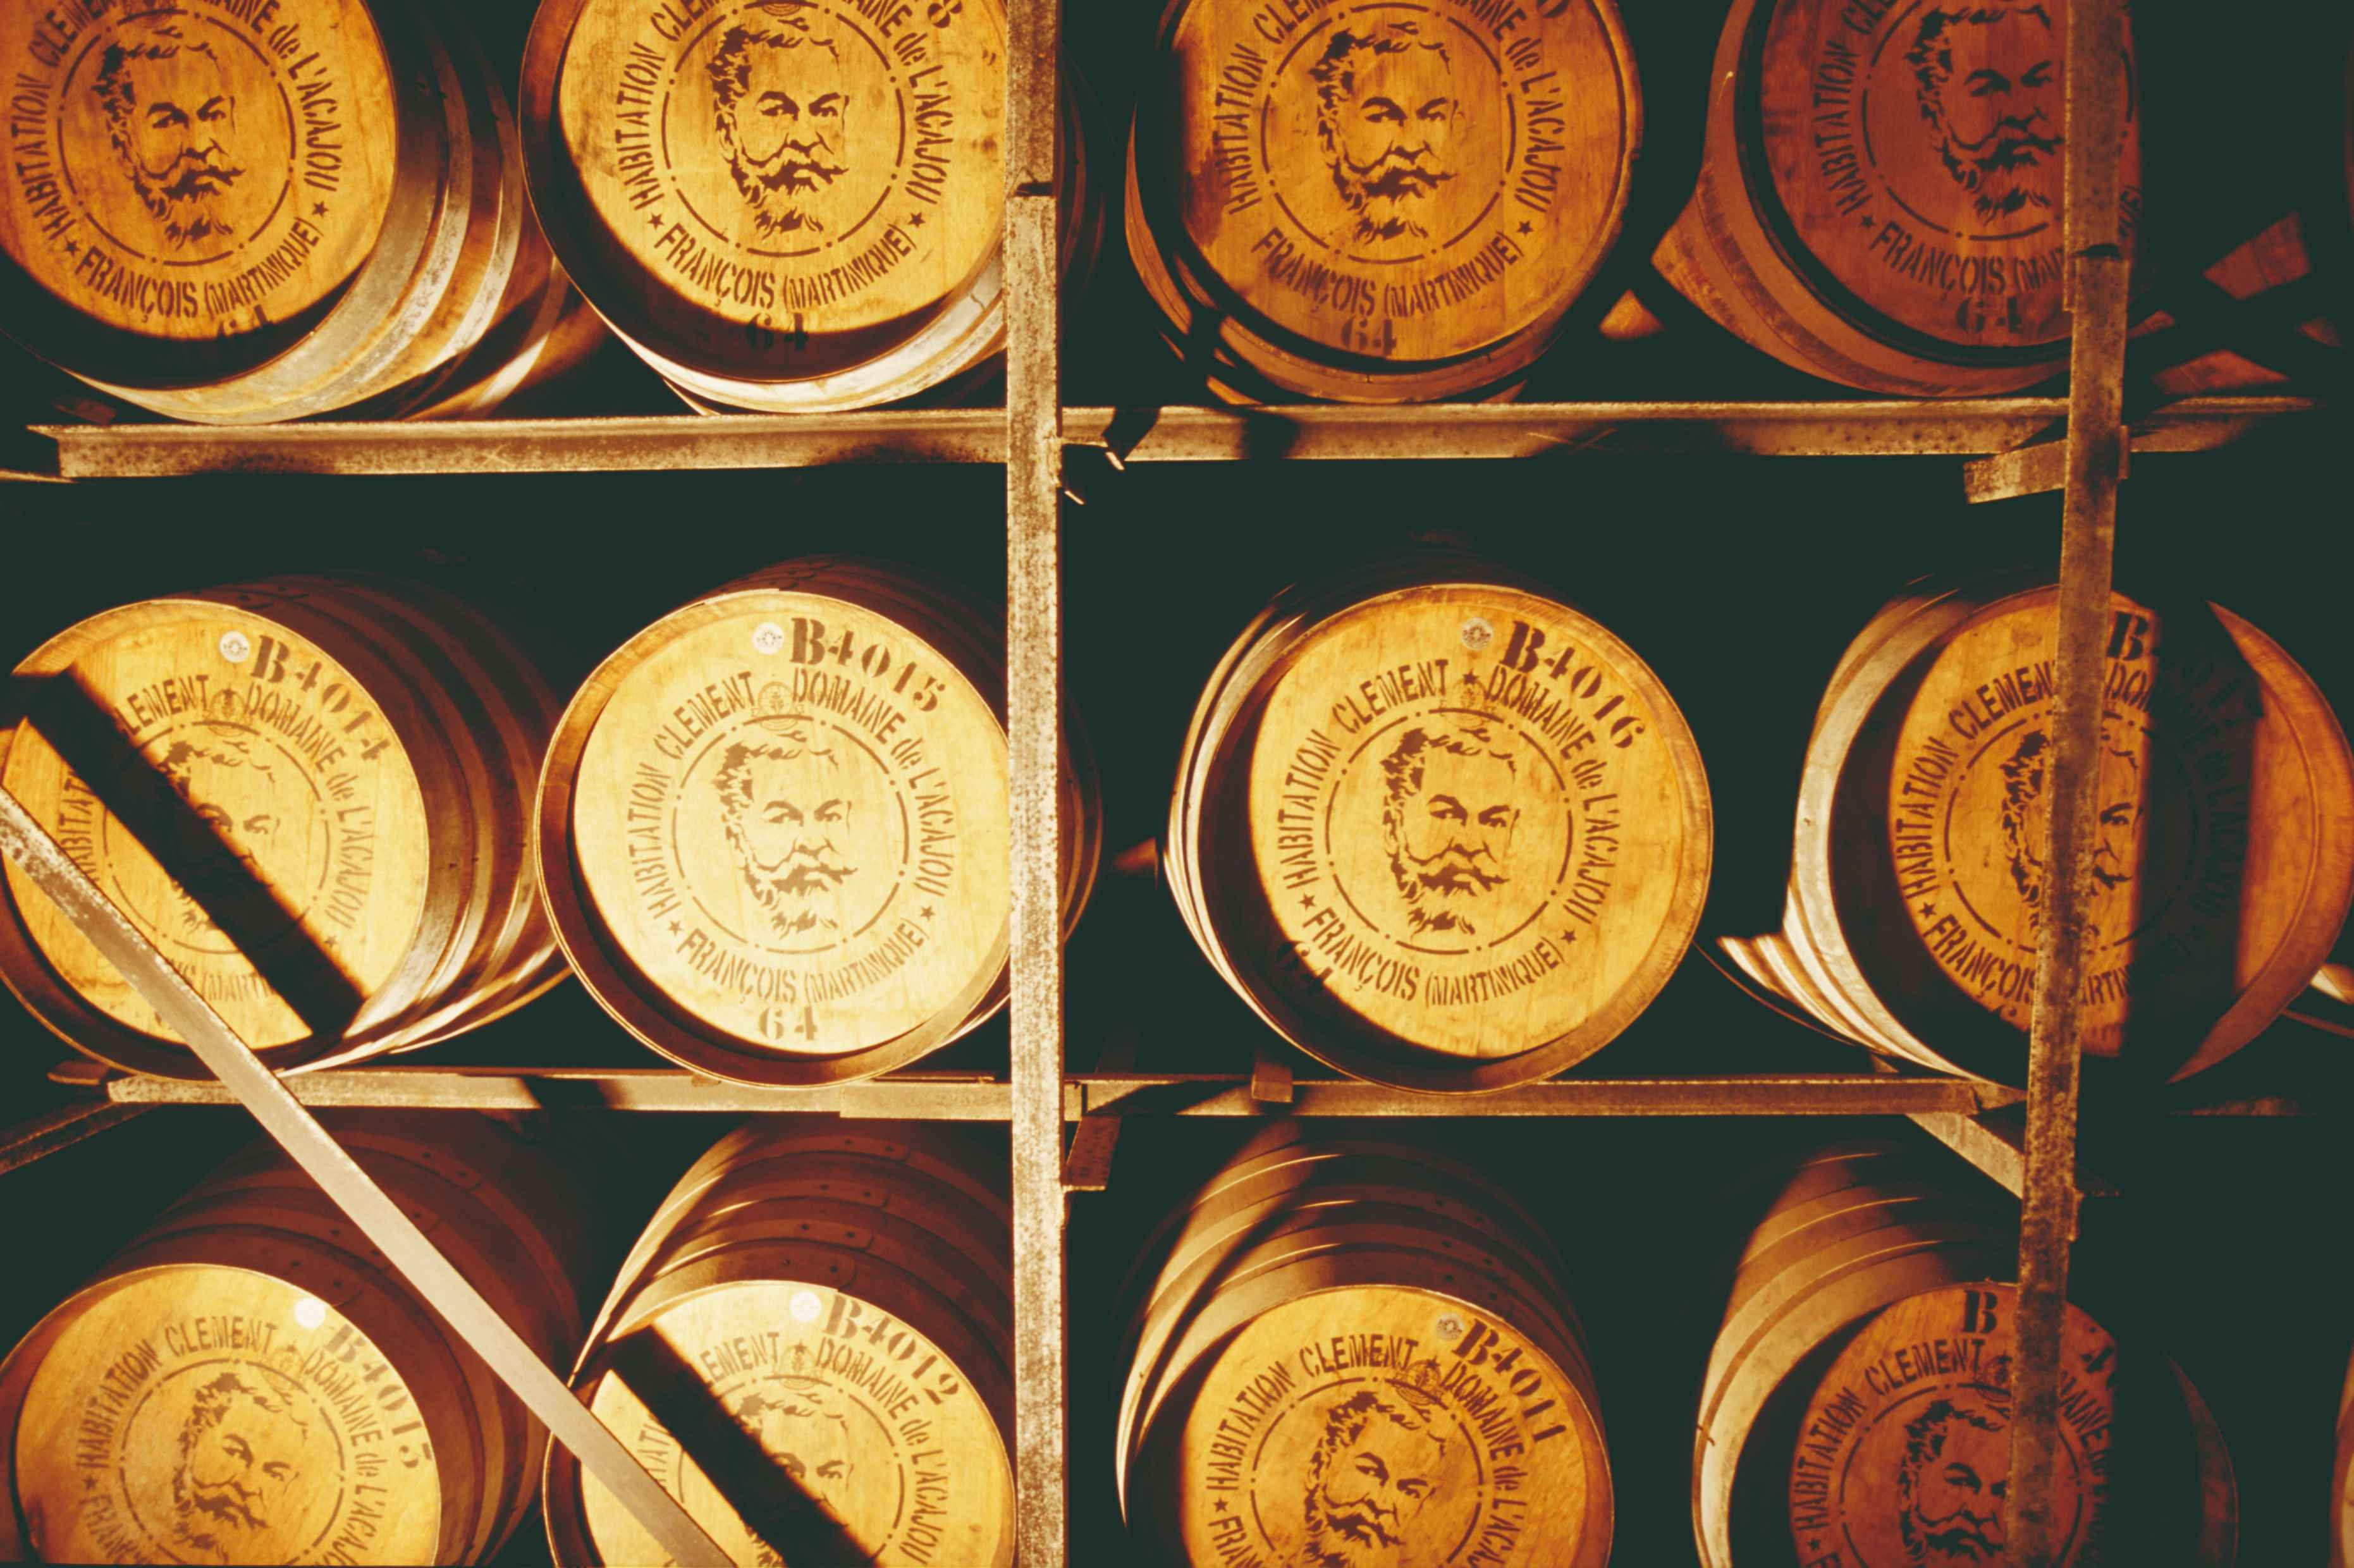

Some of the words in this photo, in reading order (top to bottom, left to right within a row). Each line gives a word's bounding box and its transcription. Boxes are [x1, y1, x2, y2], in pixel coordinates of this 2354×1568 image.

[893, 32, 928, 66] de
[1504, 37, 1542, 71] de
[11, 72, 77, 240] HABITATION
[267, 23, 301, 59] de
[287, 51, 343, 192] L'ACAJOU
[615, 42, 666, 210] HABITATION
[905, 64, 953, 205] L'ACAJOU
[1213, 43, 1268, 216] HABITATION
[1514, 70, 1566, 214] L'ACAJOU
[1814, 40, 1873, 216] HABITATION
[75, 246, 199, 322] FRANÇOIS
[653, 223, 776, 310] FRANÇOIS
[782, 223, 917, 312] (MARTINIQUE)
[1251, 226, 1376, 316] FRANÇOIS
[1383, 231, 1524, 317] (MARTINIQUE)
[1867, 221, 2006, 299] FRANÇOIS
[745, 313, 811, 352] 64
[1340, 317, 1397, 356] 64
[114, 674, 209, 735] LEMENT
[250, 634, 392, 764] B4014
[789, 616, 947, 714] B4015
[1484, 665, 1596, 760] DOMAINE
[1499, 620, 1645, 750] B4016
[245, 684, 345, 776] DOMAINE
[653, 671, 756, 760] CLEMENT
[325, 767, 359, 802] de
[793, 668, 907, 745] DOMAINE
[890, 736, 923, 771] de
[908, 768, 956, 898] L'ACAJOU
[1277, 729, 1342, 890] HABITATION
[1332, 658, 1449, 734] CLEMENT
[1571, 758, 1608, 790] de
[1896, 735, 1959, 900] HABITATION
[1948, 659, 2056, 741] CLEMEN
[325, 806, 374, 929] L'ACAJOU
[627, 762, 683, 919] HABITATION
[1562, 792, 1621, 925] L'ACAJOU
[677, 928, 798, 1004] FRANÇOIS
[804, 917, 931, 1005] (MARTINIQUE)
[1301, 907, 1421, 1001] FRANÇOIS
[1424, 936, 1565, 1008] (MARTINIQUE)
[759, 1005, 818, 1041] 64
[75, 1338, 163, 1470] HABITATION
[164, 1315, 278, 1357] CLEMENT
[301, 1347, 383, 1447] DOMAINE
[700, 1331, 780, 1383] EMENT
[815, 1337, 920, 1421] DOMAINE
[823, 1294, 960, 1406] B4012
[1452, 1318, 1567, 1442] B4011
[898, 1416, 932, 1447] de
[1206, 1360, 1297, 1491] HABITATION
[1299, 1333, 1419, 1378] CLEMENT
[1440, 1361, 1525, 1461] DOMAINE
[1793, 1386, 1869, 1533] HABITATION
[1863, 1337, 1987, 1397] CLEMENT
[354, 1453, 388, 1478] de
[898, 1449, 948, 1565] L'ACAJOU
[1493, 1466, 1528, 1491] de
[318, 1485, 388, 1565] L'ACAJ
[1466, 1498, 1528, 1568] L'ACA
